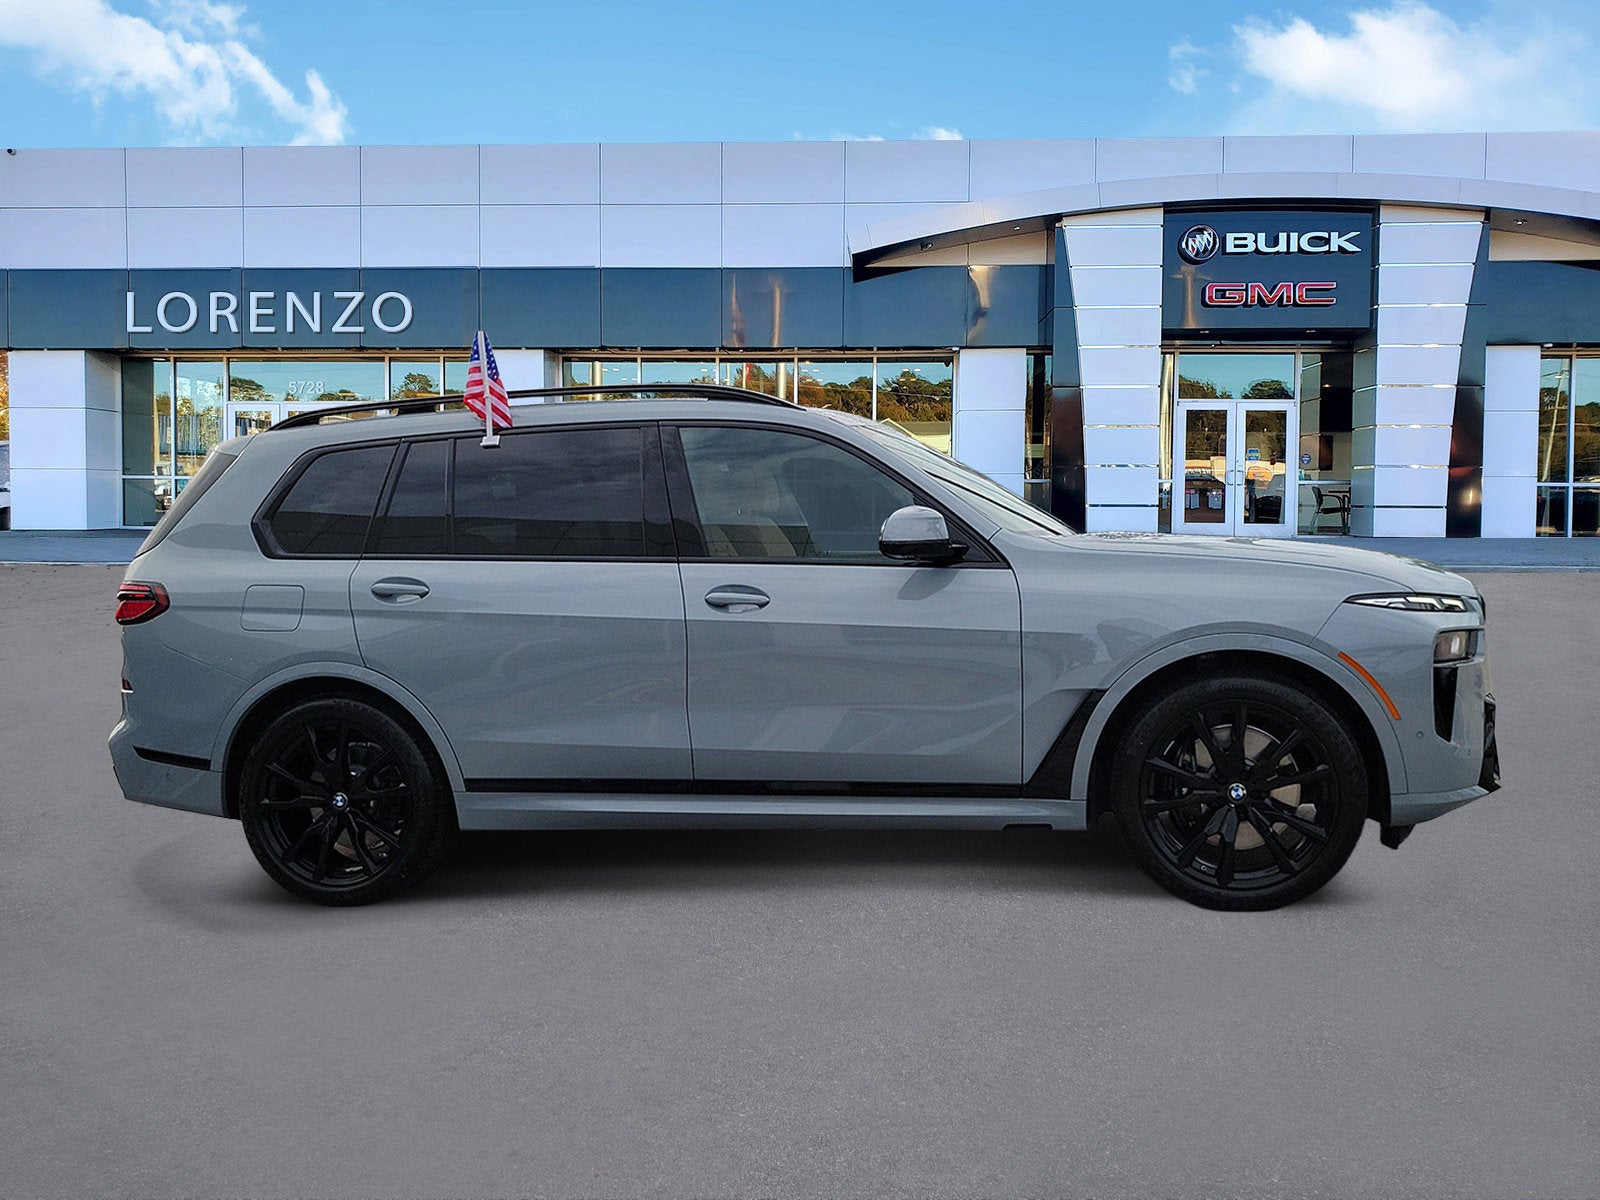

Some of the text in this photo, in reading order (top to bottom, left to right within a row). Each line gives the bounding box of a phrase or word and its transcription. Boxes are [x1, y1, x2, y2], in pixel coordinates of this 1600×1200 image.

[1225, 231, 1362, 253] BUICK
[1206, 281, 1337, 306] GMC
[126, 291, 413, 333] LORENZO
[288, 380, 325, 394] 5728
